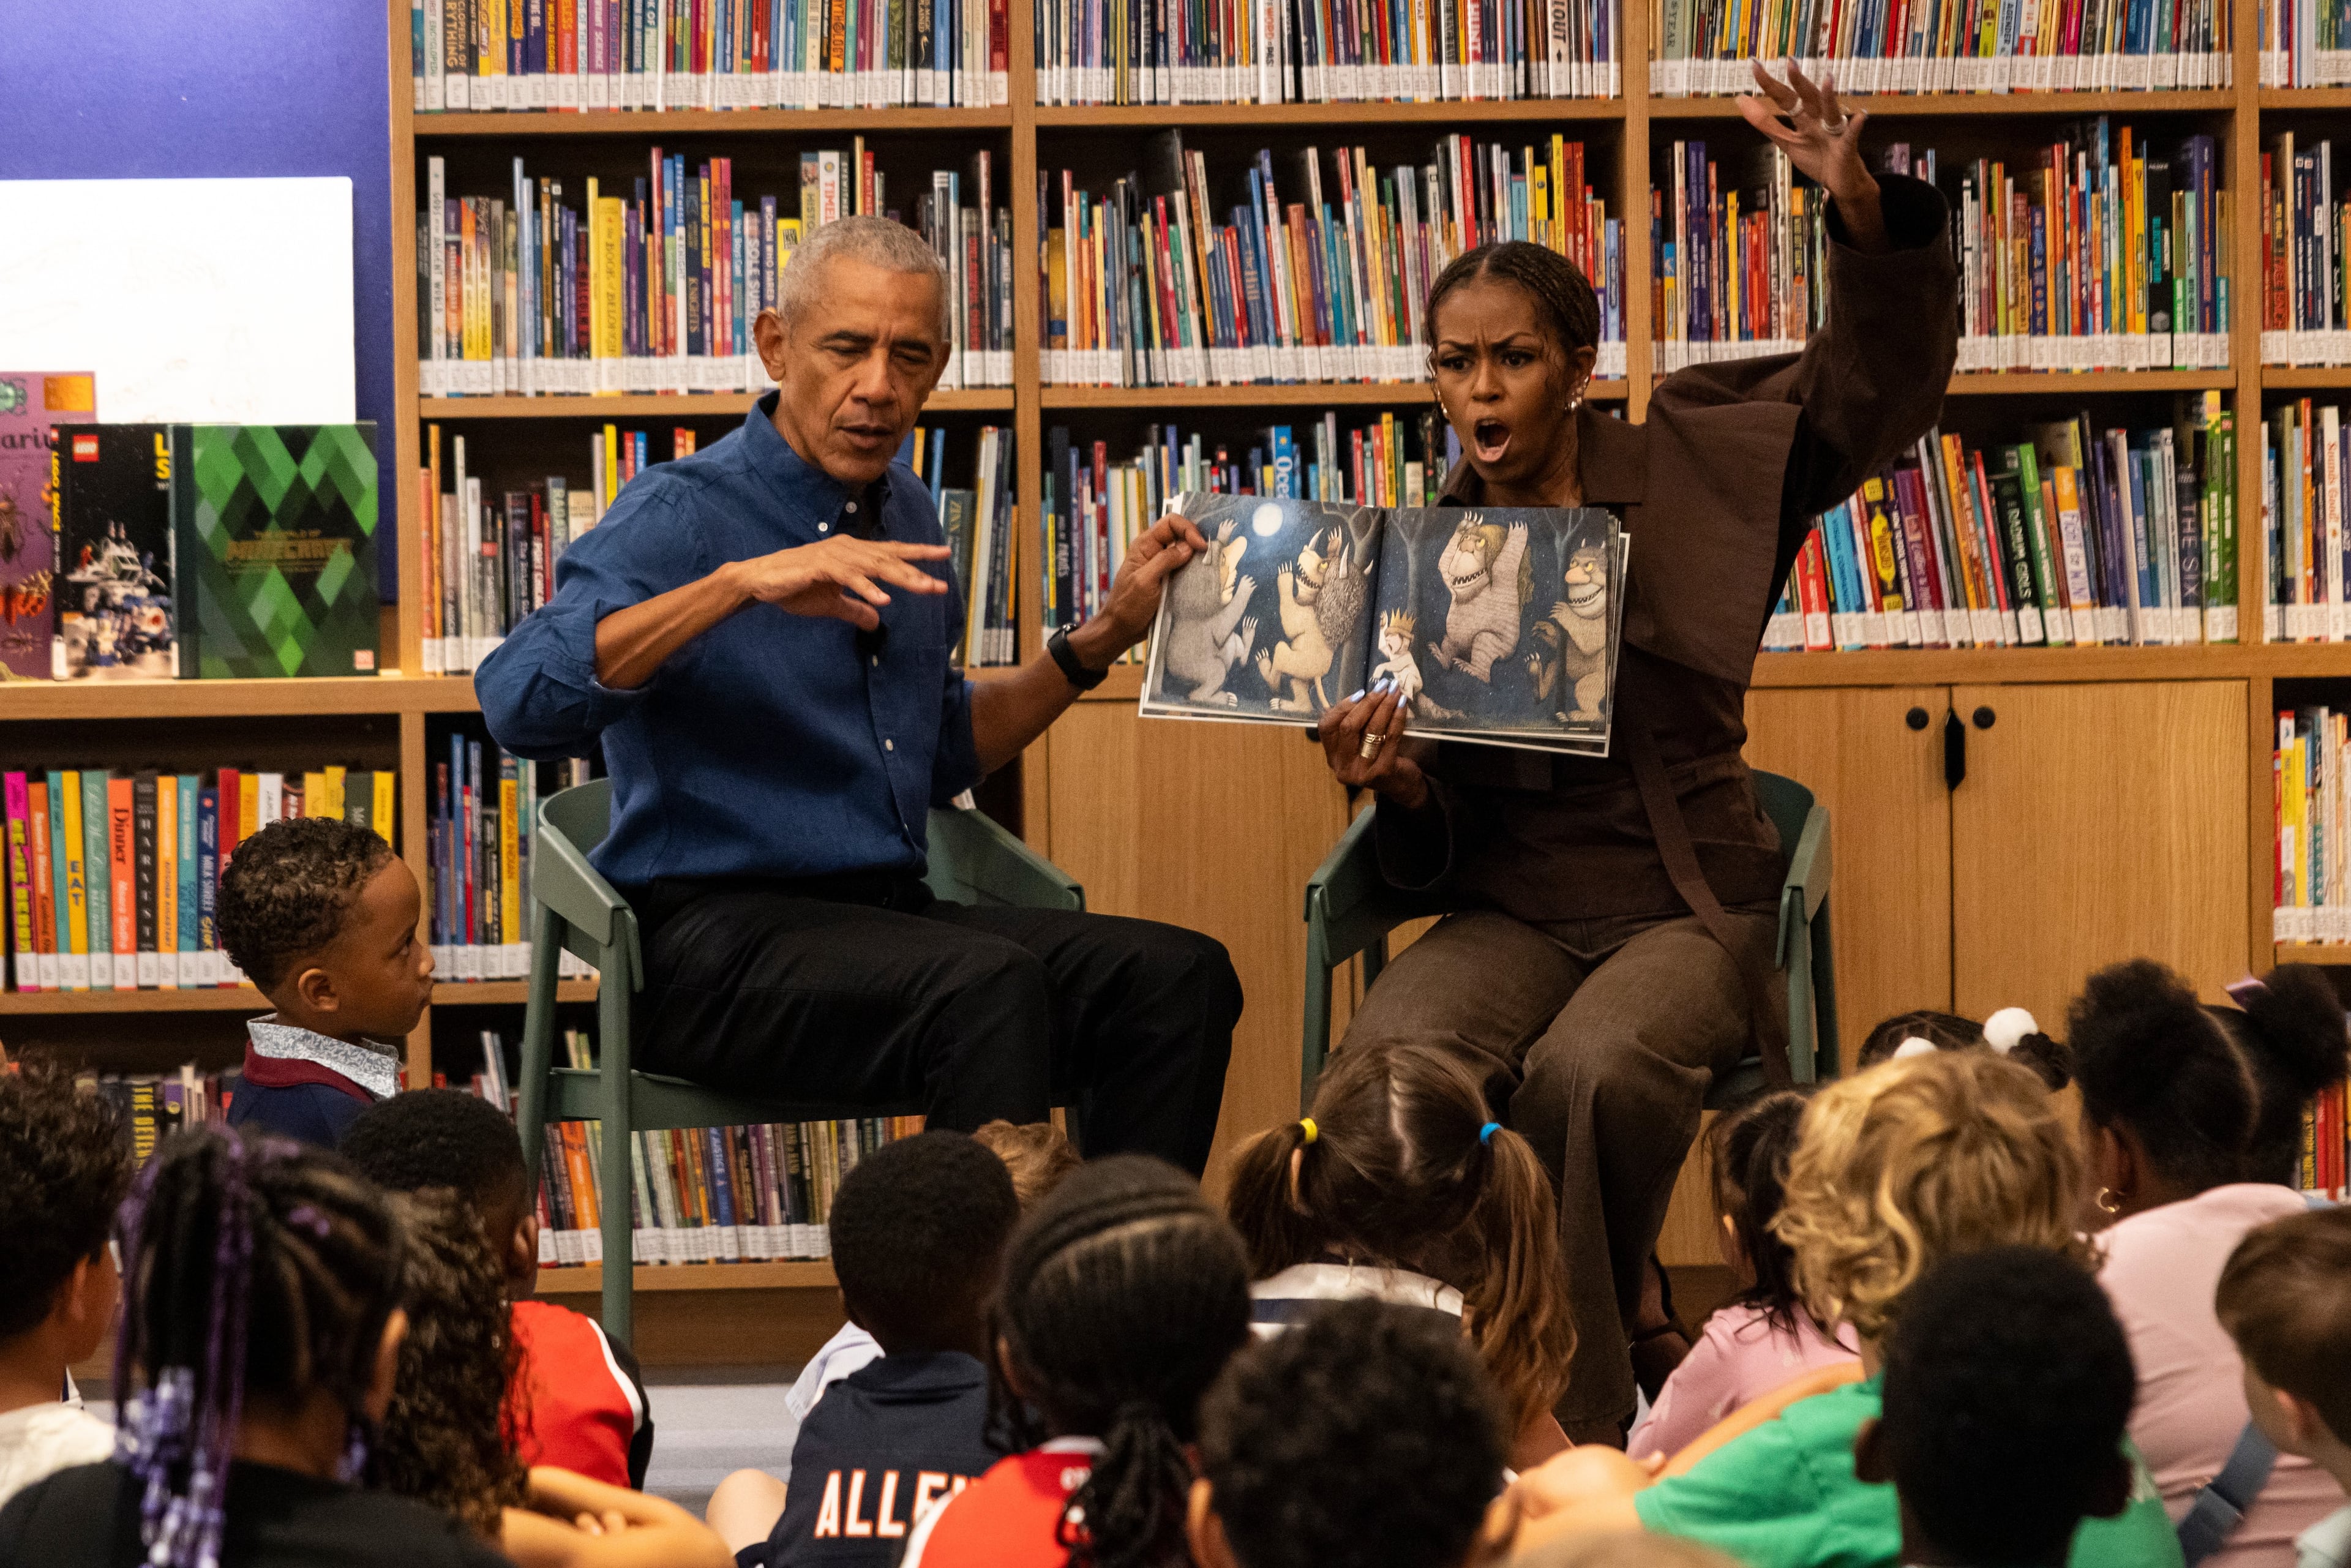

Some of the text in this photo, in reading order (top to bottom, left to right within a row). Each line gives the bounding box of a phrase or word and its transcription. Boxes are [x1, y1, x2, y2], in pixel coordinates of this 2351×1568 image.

[579, 13, 587, 24] OF
[647, 12, 656, 26] OF
[458, 54, 466, 68] OF
[807, 193, 816, 232] HISTO
[749, 239, 759, 276] SOLE
[689, 277, 699, 333] KNIGHTS
[75, 443, 97, 454] LEGO
[2182, 503, 2199, 597] THE SIX
[2017, 562, 2031, 599] GIRLS
[114, 808, 129, 865] Dinner
[70, 861, 84, 906] EAT
[712, 1137, 724, 1174] JUSTICE
